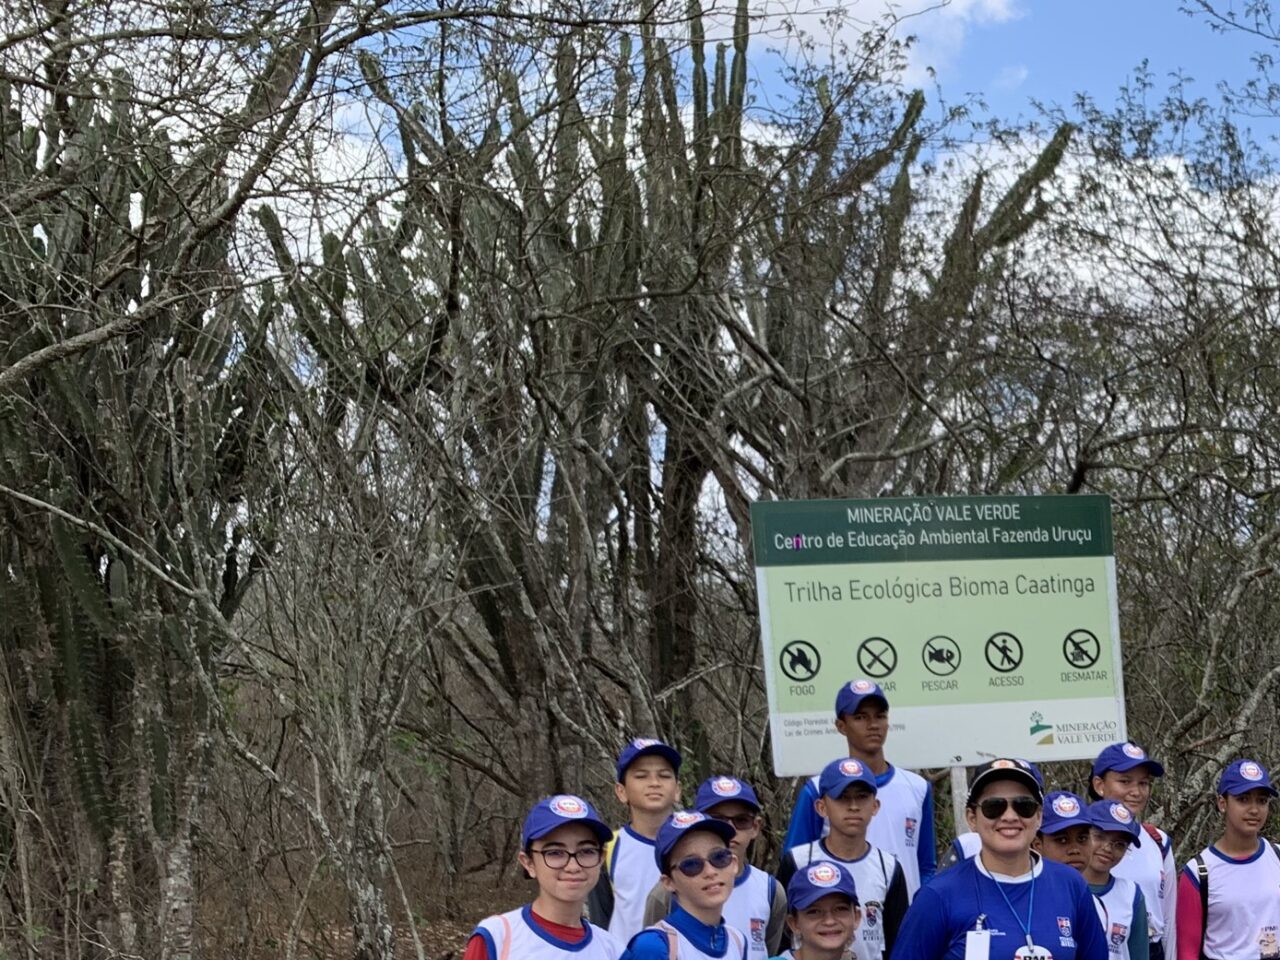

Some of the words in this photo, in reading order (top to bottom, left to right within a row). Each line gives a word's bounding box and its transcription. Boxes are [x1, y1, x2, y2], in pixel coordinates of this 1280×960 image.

[847, 503, 932, 526] MINERAÇÃO
[935, 504, 971, 521] VALE
[975, 503, 1021, 520] VERDE
[774, 533, 823, 550] Centro
[826, 532, 844, 548] de
[847, 530, 916, 550] Educação
[919, 527, 990, 545] Ambiental
[993, 526, 1049, 543] Fazenda
[1052, 525, 1092, 545] Uruçu
[784, 581, 843, 602] Trilha
[849, 576, 943, 604] Ecológica
[949, 576, 1009, 597] Bioma
[1015, 573, 1095, 598] Caatinga
[989, 675, 1025, 687] ACESSO
[1060, 670, 1108, 682] DESMATAR
[789, 685, 816, 697] FOGO
[921, 680, 959, 692] PESCAR
[1056, 720, 1117, 733] MINERAÇÃO
[1057, 733, 1083, 744] VALE
[1085, 731, 1117, 742] VERDE
